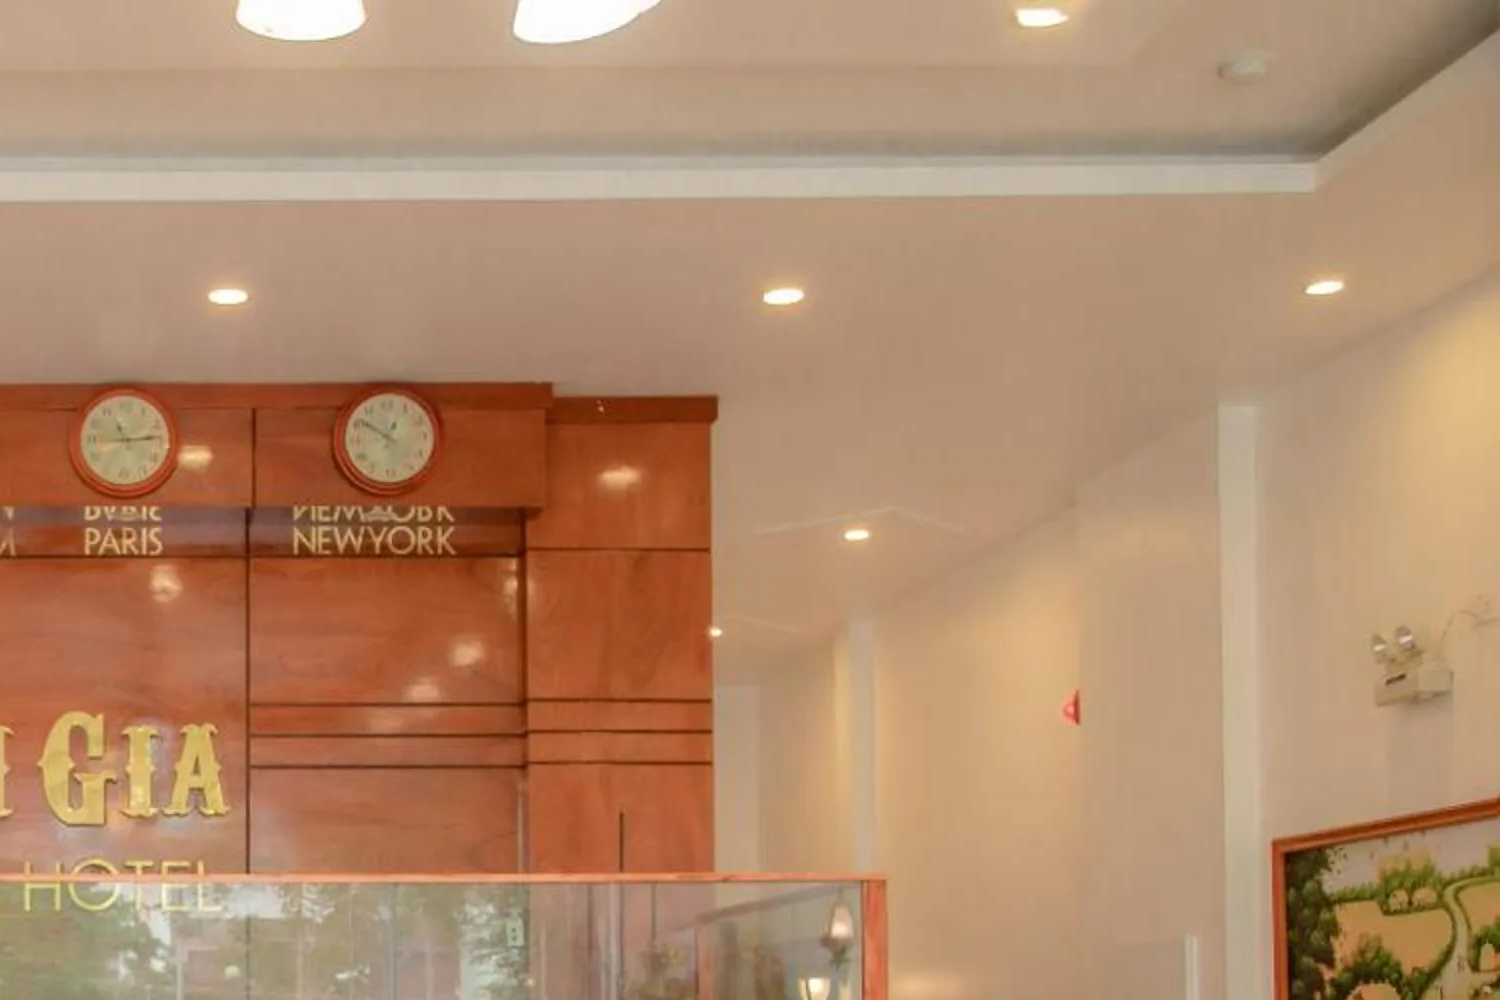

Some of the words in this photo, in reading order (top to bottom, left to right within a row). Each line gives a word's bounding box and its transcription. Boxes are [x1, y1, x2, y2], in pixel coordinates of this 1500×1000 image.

[84, 527, 163, 556] PARIS
[292, 526, 457, 555] NEWYORK
[37, 711, 231, 827] GIA
[23, 860, 222, 912] HOTEL
